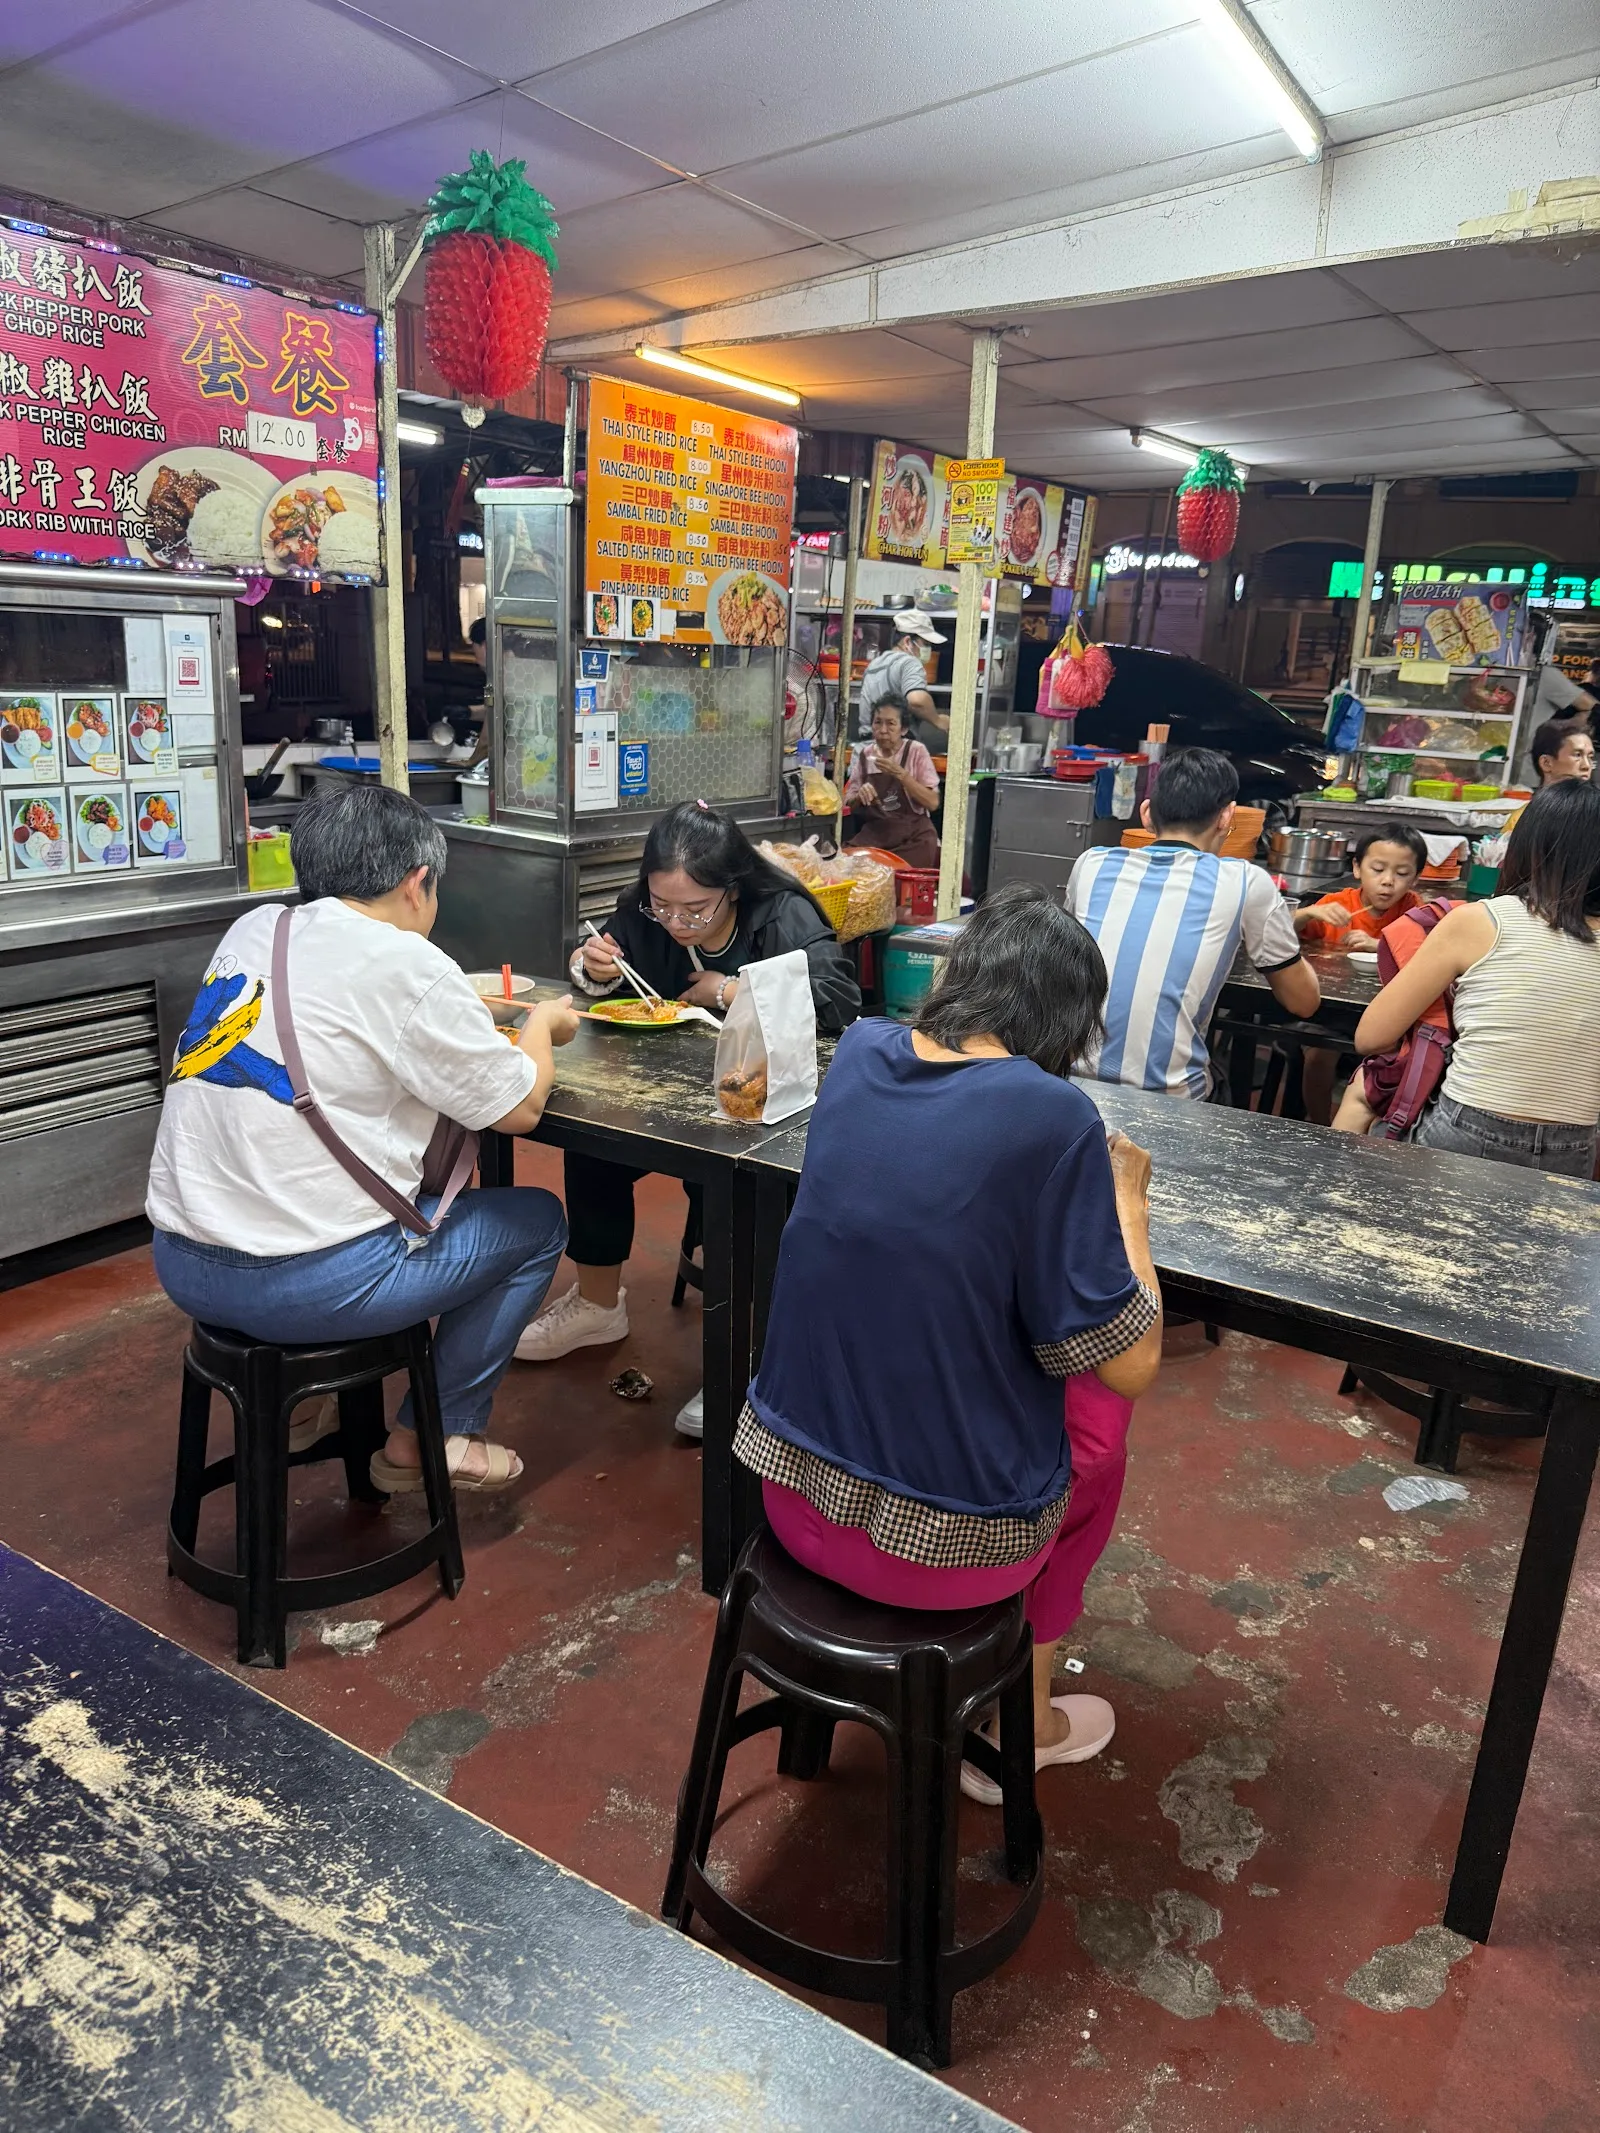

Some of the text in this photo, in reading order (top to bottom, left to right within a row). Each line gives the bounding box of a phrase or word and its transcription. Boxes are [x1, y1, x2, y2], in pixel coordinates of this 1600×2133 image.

[23, 296, 94, 327] PEPPER
[97, 312, 147, 338] PORK
[4, 313, 105, 348] CHOP RICE
[181, 293, 350, 416] 套餐
[16, 404, 87, 430] PEPPER
[90, 415, 166, 442] CHICKEN
[625, 403, 676, 432] 泰式炒飯
[43, 427, 86, 449] RICE
[219, 419, 305, 449] RM 12.00
[603, 418, 697, 452] THAI STYLE FRIED RICE
[709, 444, 787, 473] THAI STYLE BEE HOON
[599, 459, 697, 491] YANGZHOU FRIED RICE
[721, 463, 774, 491] 星州炒米粉
[622, 484, 673, 510] 三巴炒飯
[705, 481, 786, 507] SINGAPORE BEE HOON
[607, 501, 688, 527] SAMBAL FRIED RICE
[719, 500, 771, 525] 三巴炒米粉
[35, 514, 67, 533] RIB
[68, 516, 113, 536] WITH
[117, 521, 156, 539] RICE
[621, 525, 671, 548] 咸魚炒飯
[710, 518, 778, 540] SAMBAL BEE HOON
[597, 540, 694, 565] SALTED FISH FRIED RICE
[717, 536, 769, 559] 咸魚炒米粉
[701, 553, 783, 573] SALTED FISH BEE HOON
[601, 580, 689, 602] PINEAPPLE FRIED RICE
[1403, 584, 1461, 599] POPIAH
